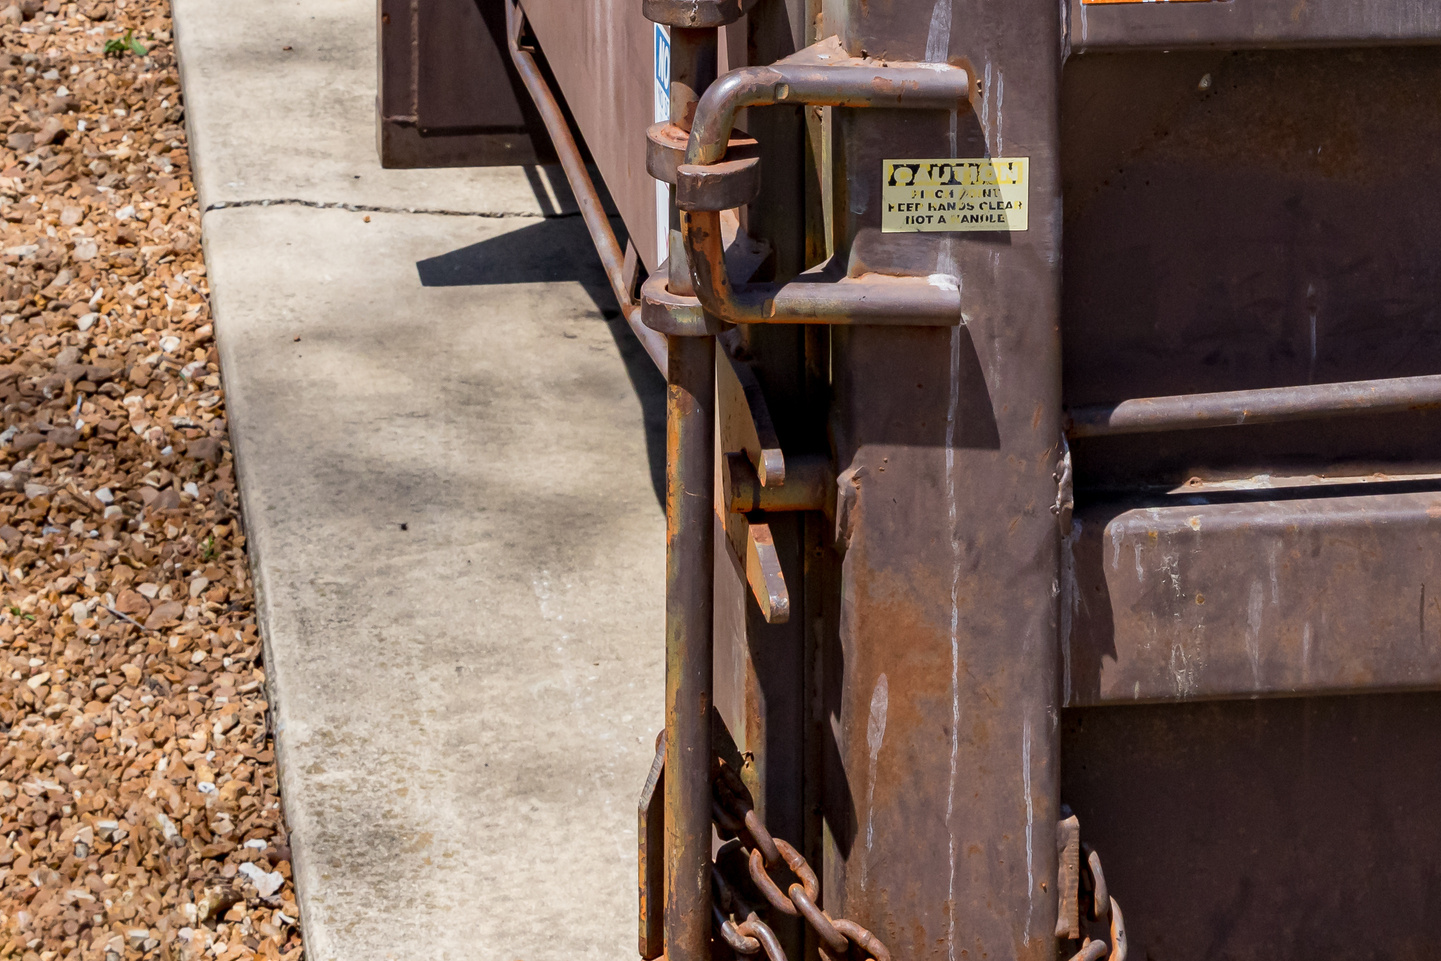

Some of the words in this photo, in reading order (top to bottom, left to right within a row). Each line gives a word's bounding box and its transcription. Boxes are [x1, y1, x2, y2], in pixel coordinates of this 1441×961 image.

[894, 166, 1018, 183] CAUTION
[888, 202, 923, 212] KEEP
[928, 201, 975, 211] HANDS
[979, 201, 1022, 210] CLEAR
[905, 215, 933, 224] NOT
[937, 215, 947, 224] A
[951, 214, 1005, 224] ANDLE
